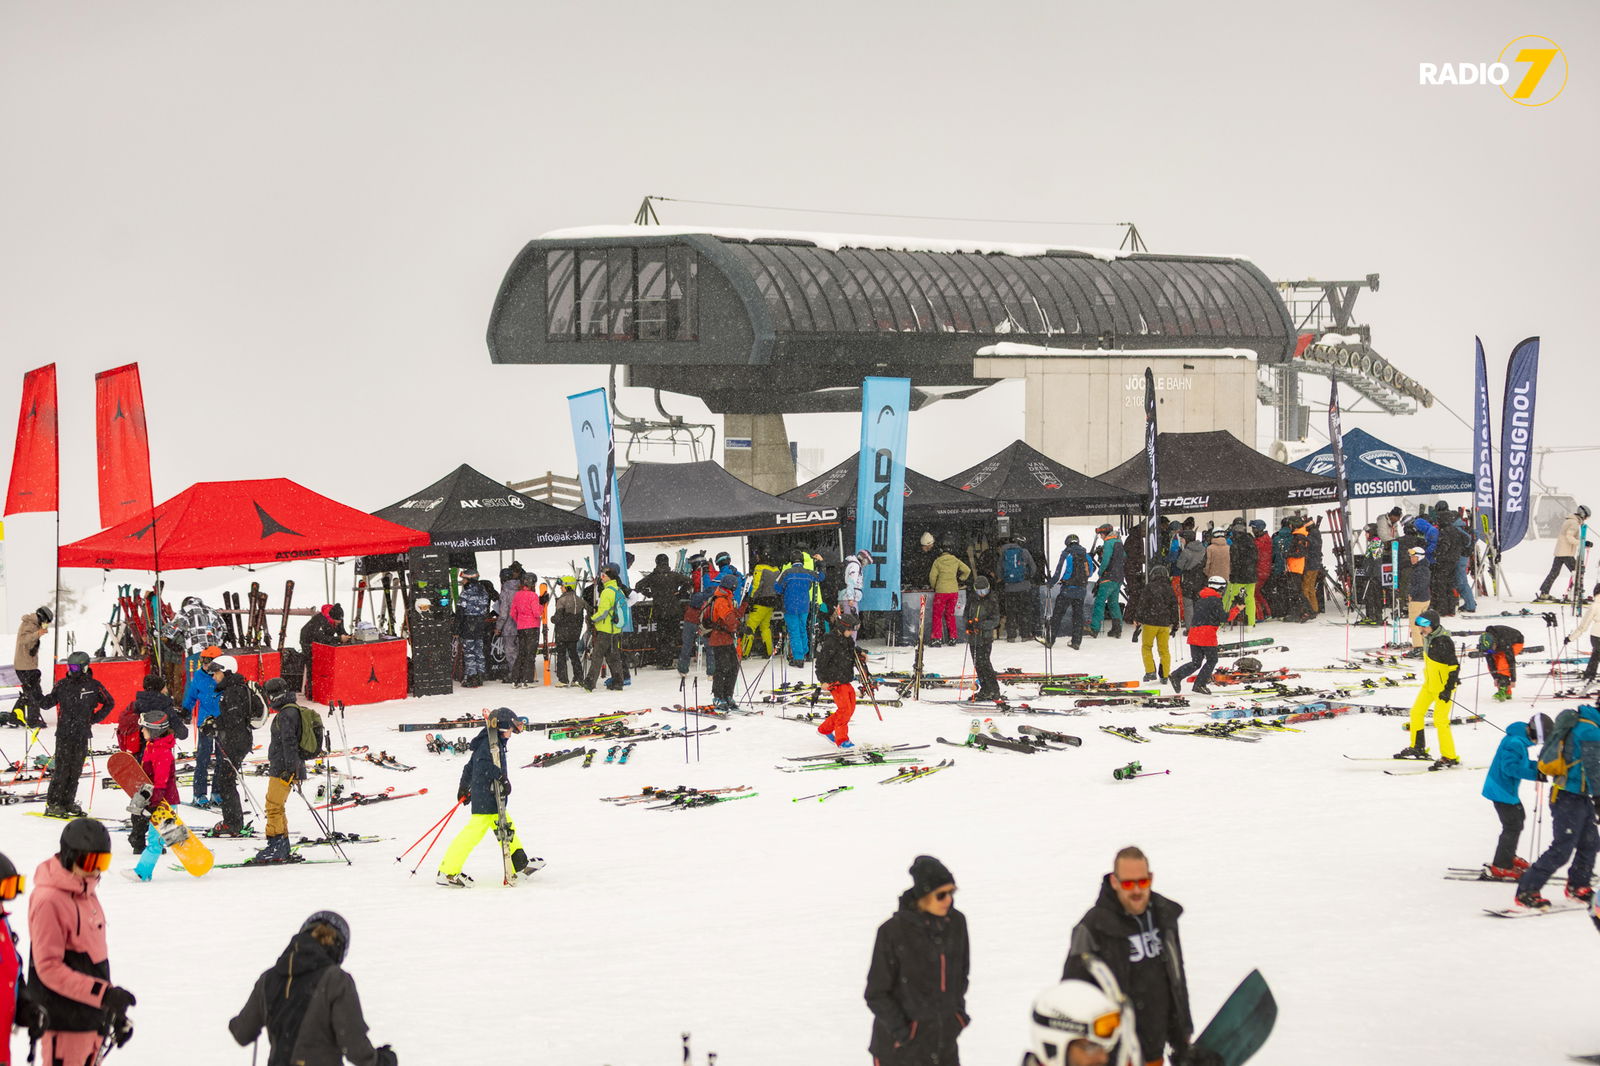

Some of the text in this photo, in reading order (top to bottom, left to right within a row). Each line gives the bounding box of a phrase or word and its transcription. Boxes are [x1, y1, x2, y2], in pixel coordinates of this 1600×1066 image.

[1125, 374, 1192, 391] JÖCLE BAHN
[1506, 381, 1530, 513] ROSSIGNOL
[1288, 486, 1338, 498] STÖCKLI
[1354, 480, 1416, 495] ROSSIGNOL
[1431, 483, 1472, 491] ROSSIGNOL.COM
[460, 499, 510, 508] AK SKI
[1160, 495, 1209, 507] STÖCKLI
[776, 509, 838, 525] HEAD
[870, 447, 893, 589] HEAD
[536, 531, 597, 542] info@ak-ski.eu
[275, 548, 321, 560] ATOMIC
